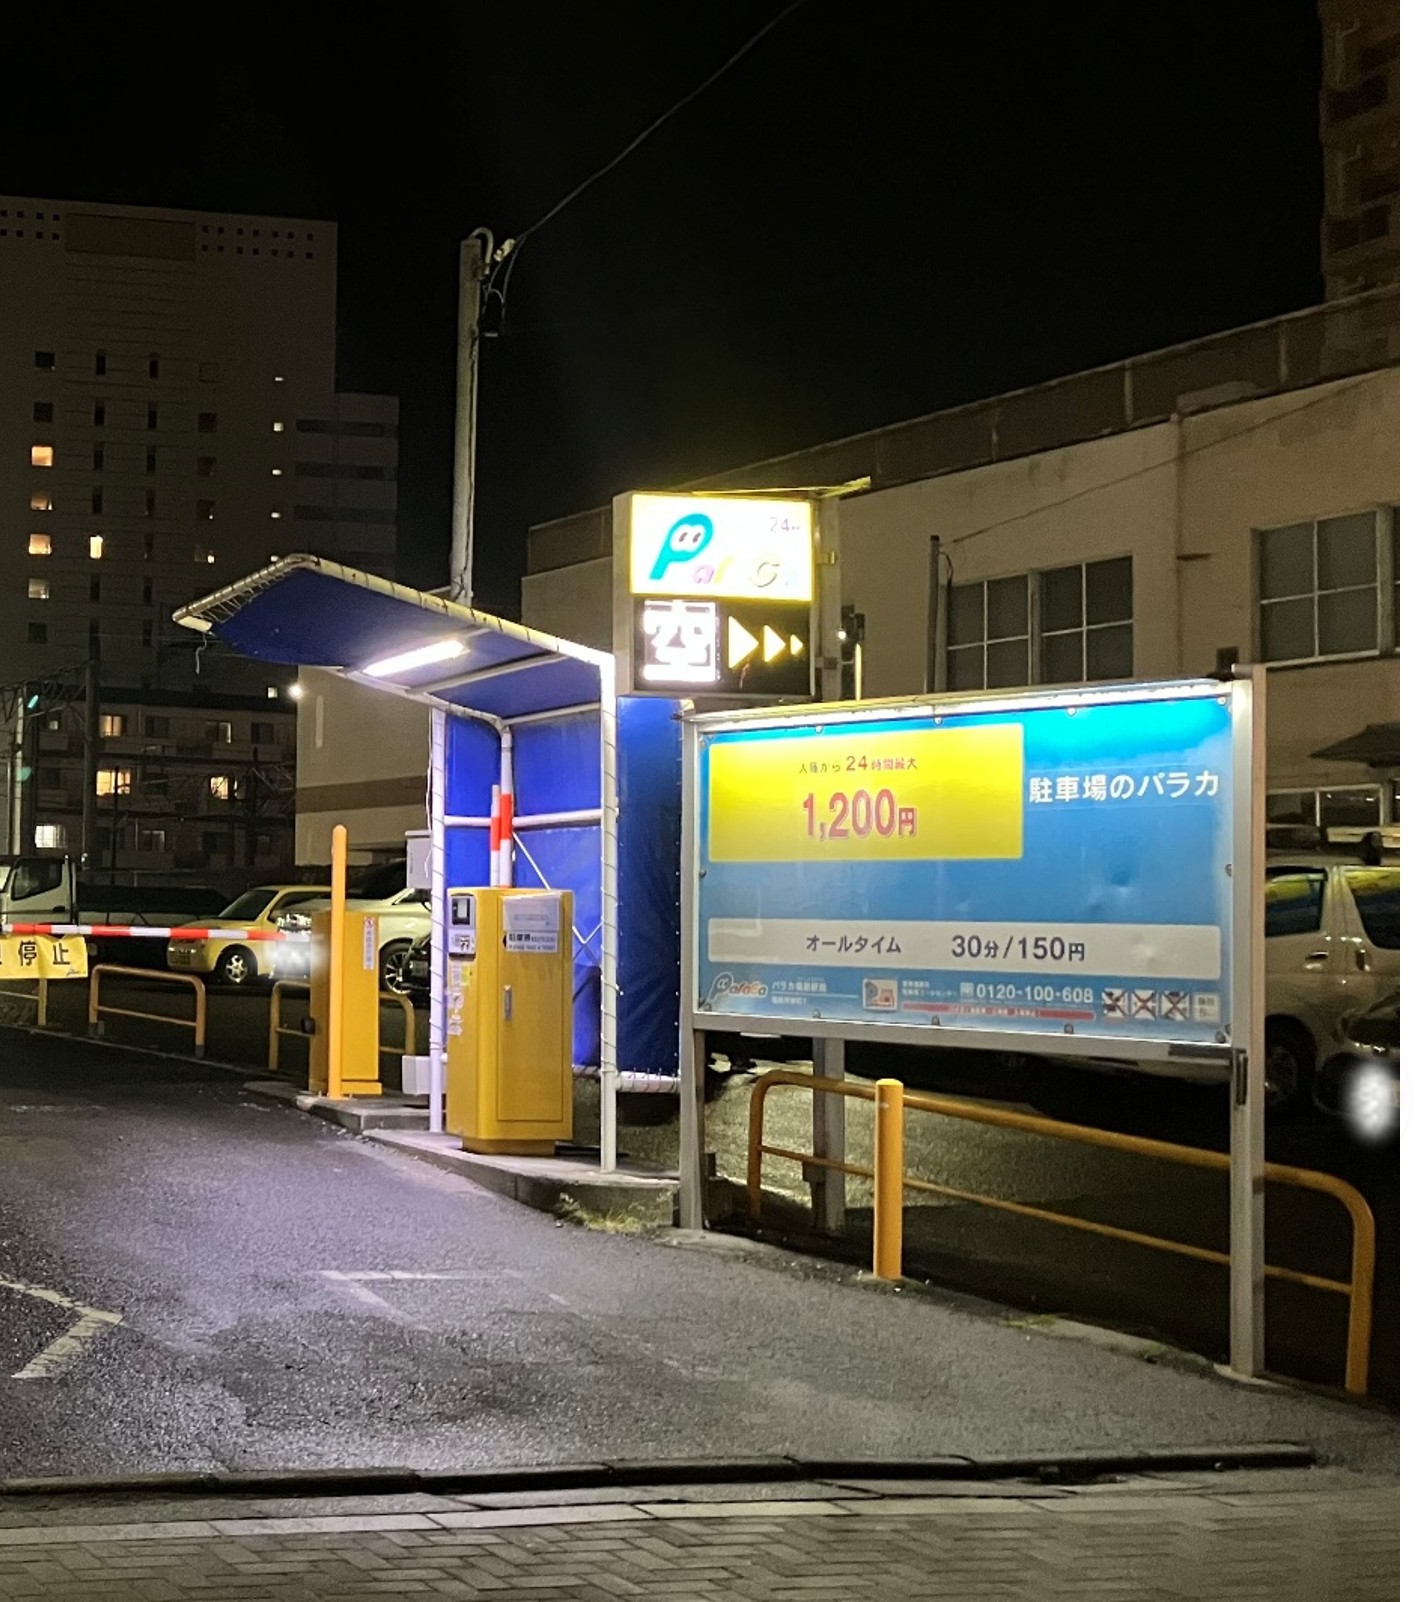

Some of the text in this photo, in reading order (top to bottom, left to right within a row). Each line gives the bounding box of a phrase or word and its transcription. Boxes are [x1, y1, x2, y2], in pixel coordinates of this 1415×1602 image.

[1029, 769, 1219, 804] 駐車場のパラカ
[802, 788, 918, 841] 1,200円
[805, 934, 1085, 962] オールタイム 30分/150円
[976, 983, 1094, 1003] 0120-100-608
